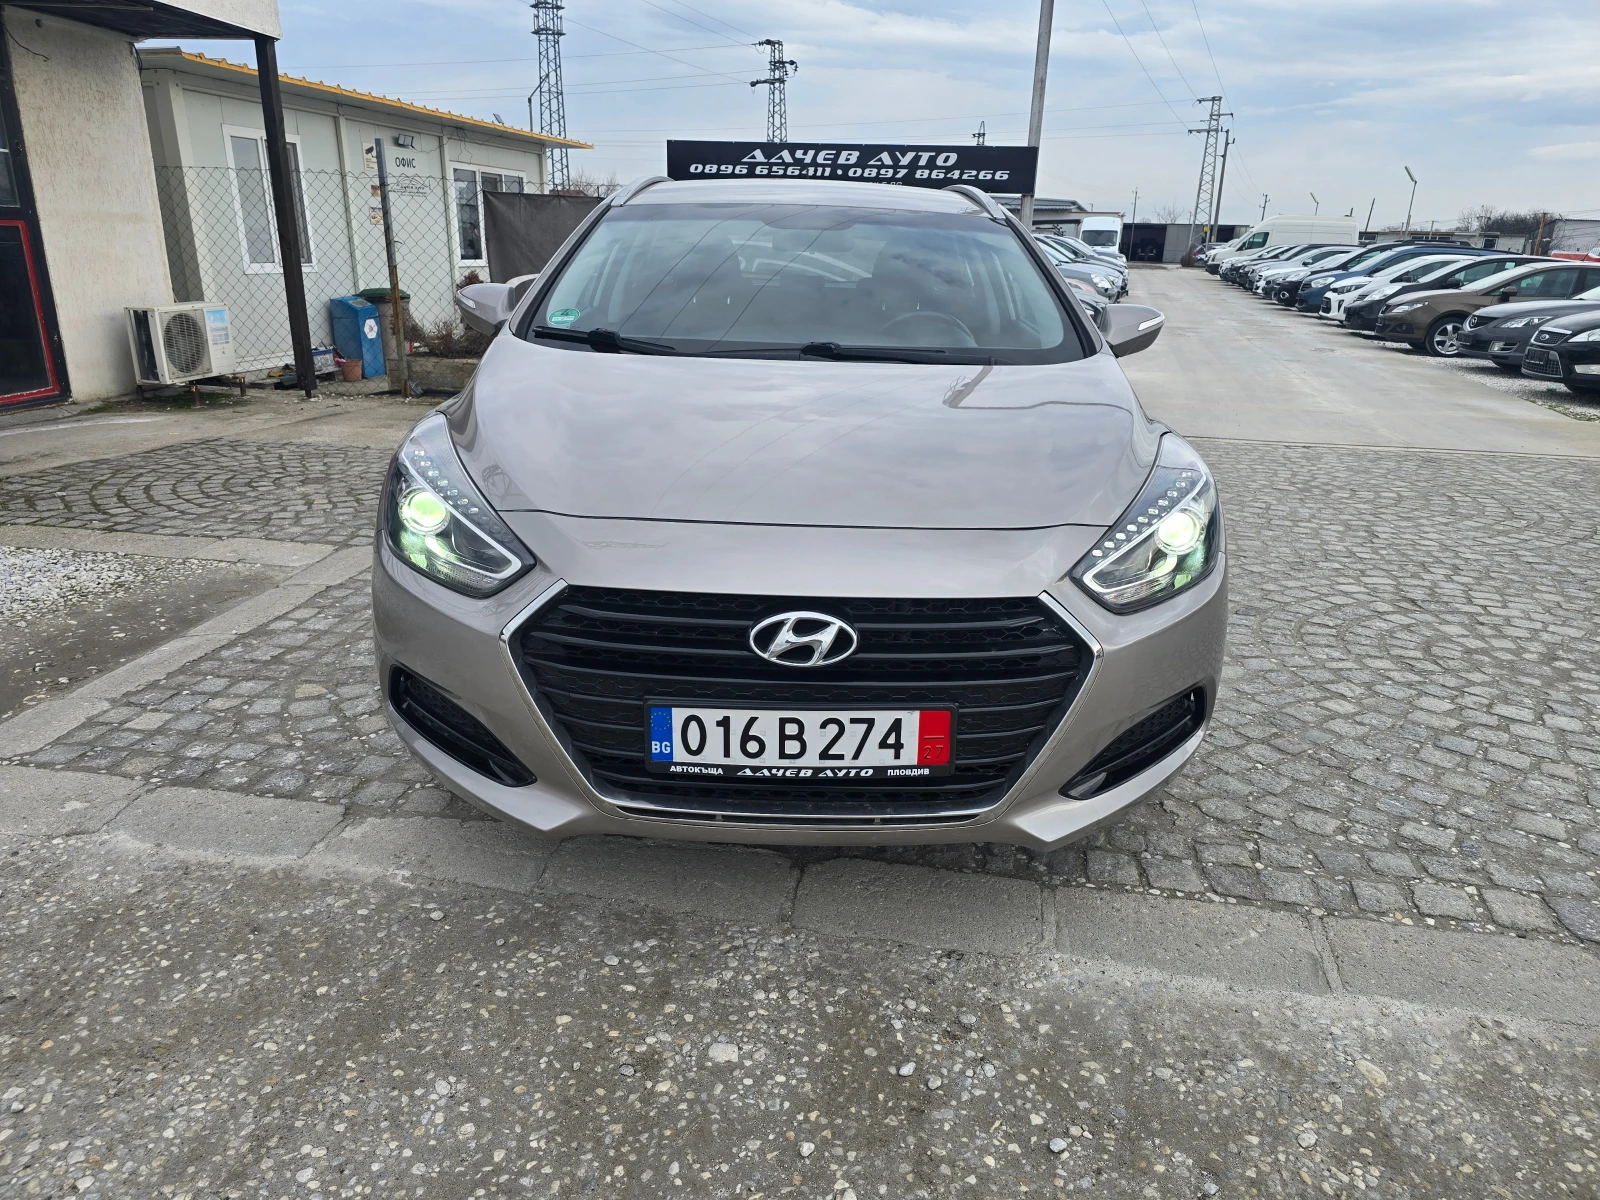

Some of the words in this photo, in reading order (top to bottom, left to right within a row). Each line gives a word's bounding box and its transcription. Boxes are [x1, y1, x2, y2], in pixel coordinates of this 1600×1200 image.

[394, 156, 417, 169] ОФИС
[740, 148, 860, 165] ДАЧЕВ
[867, 151, 958, 167] АУТО
[689, 163, 749, 175] 0896
[754, 165, 832, 177] 656411
[847, 167, 909, 179] 0897
[914, 169, 1011, 181] 864266
[651, 741, 671, 754] BG
[669, 765, 724, 775] АВТОКЪЩА
[736, 767, 812, 777] ДАЧЕВ
[817, 768, 874, 777] АУТО
[887, 767, 930, 776] ПЛОВДИВ
